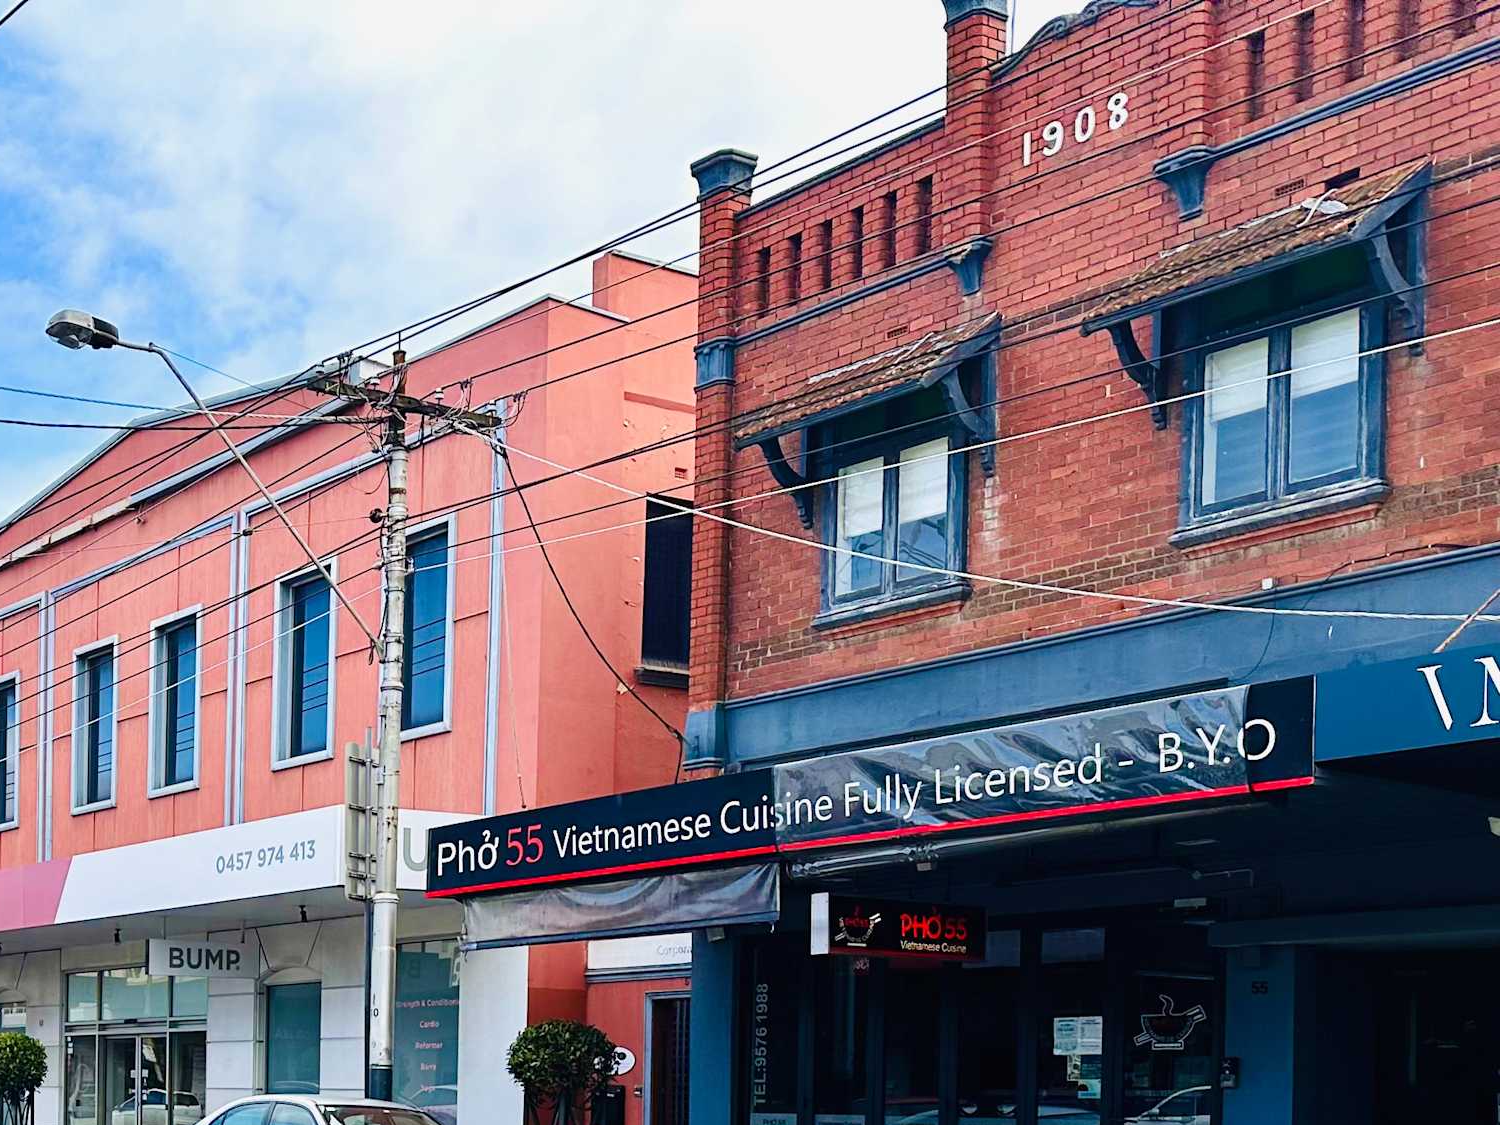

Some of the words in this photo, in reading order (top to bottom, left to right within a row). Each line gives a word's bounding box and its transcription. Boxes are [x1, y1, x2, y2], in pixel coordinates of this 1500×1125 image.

[1023, 92, 1129, 167] 1908
[436, 829, 499, 876] Phở
[505, 824, 544, 866] 55
[553, 813, 711, 858] Vietnamese
[720, 793, 832, 835] Cuisine
[844, 773, 923, 821] Fully
[935, 742, 1102, 804] Licensed
[216, 851, 253, 874] 0457
[257, 845, 285, 868] 974
[289, 839, 316, 861] 413
[900, 940, 941, 952] Vietnamese
[942, 943, 967, 953] Cuisine
[945, 918, 969, 940] 55
[756, 983, 769, 1023] 1988
[420, 1021, 440, 1029] Cardio
